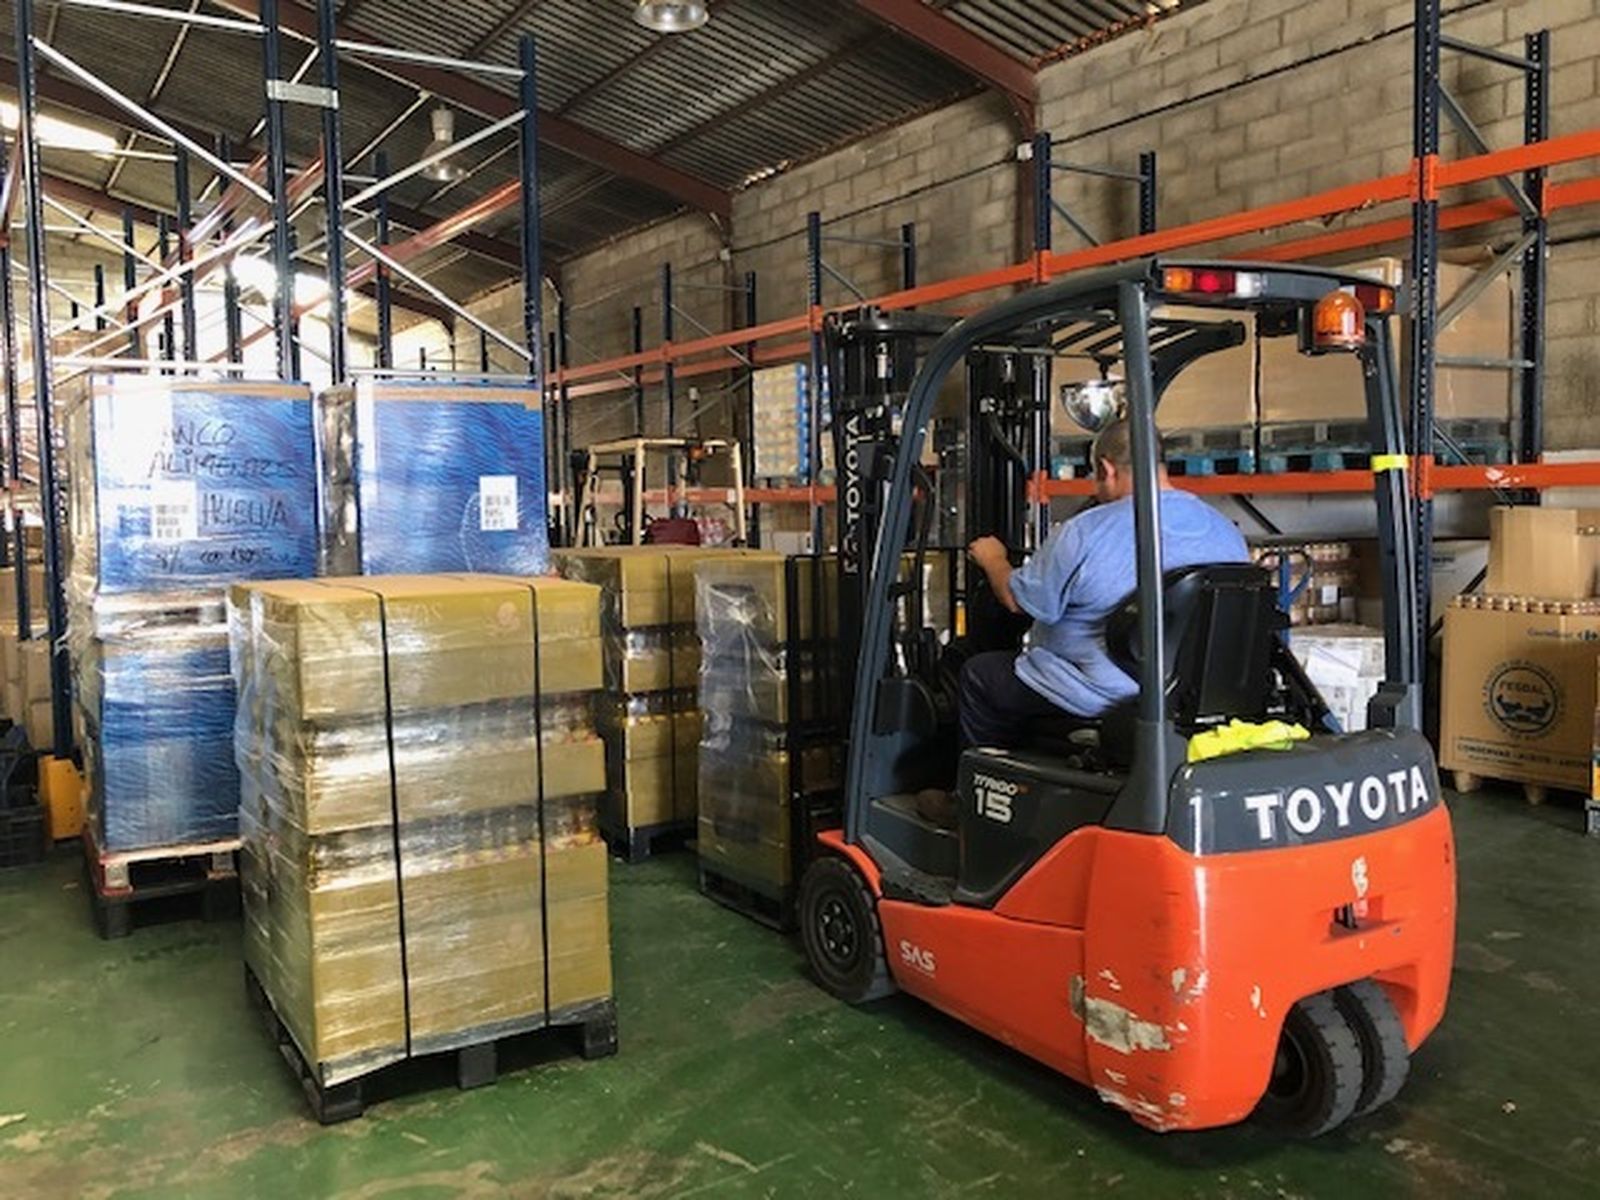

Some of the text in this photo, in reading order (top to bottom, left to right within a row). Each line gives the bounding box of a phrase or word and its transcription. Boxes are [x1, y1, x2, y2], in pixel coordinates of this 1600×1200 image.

[845, 415, 860, 525] TOYOTA
[975, 787, 1012, 823] 15
[1244, 765, 1429, 840] TOYOTA
[900, 940, 936, 971] SAS
